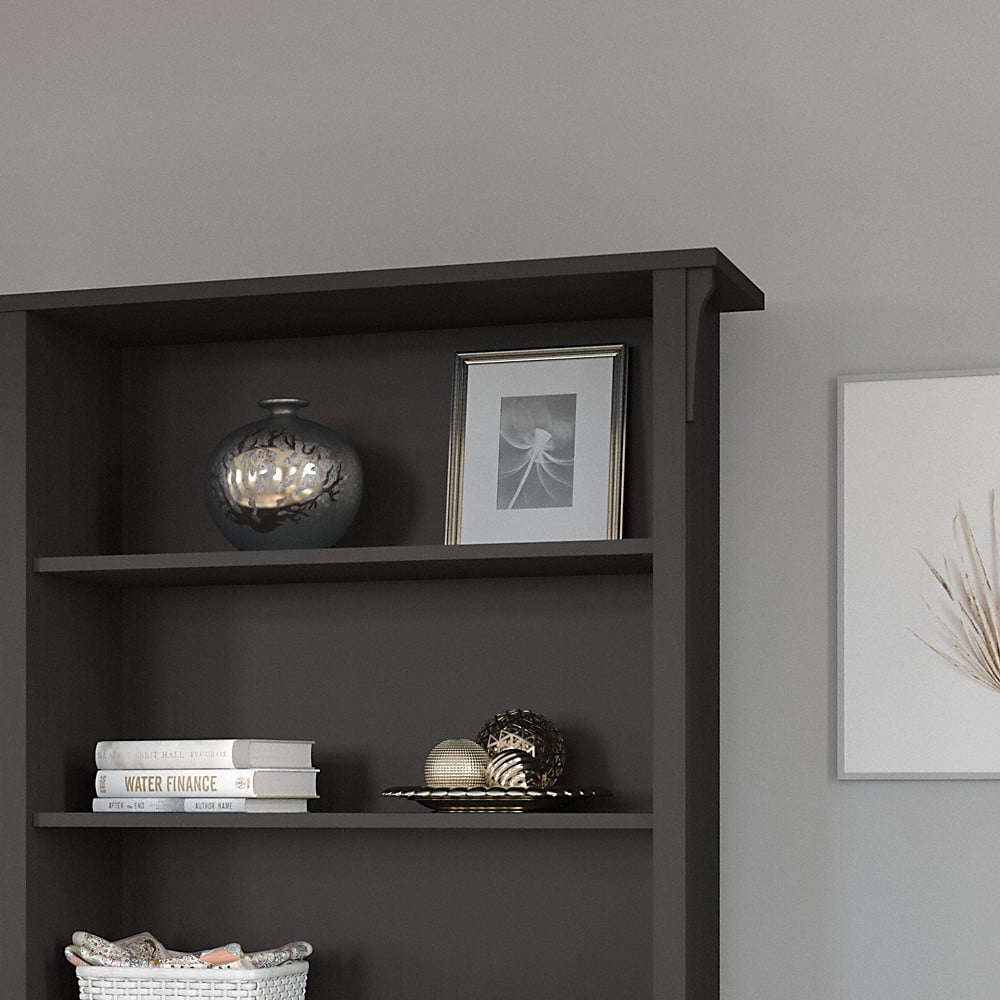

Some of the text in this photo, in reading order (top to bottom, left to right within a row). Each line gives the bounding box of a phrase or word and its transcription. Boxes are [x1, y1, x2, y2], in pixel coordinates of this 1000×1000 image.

[161, 751, 184, 759] HALL
[124, 775, 217, 792] WATER FINANCE
